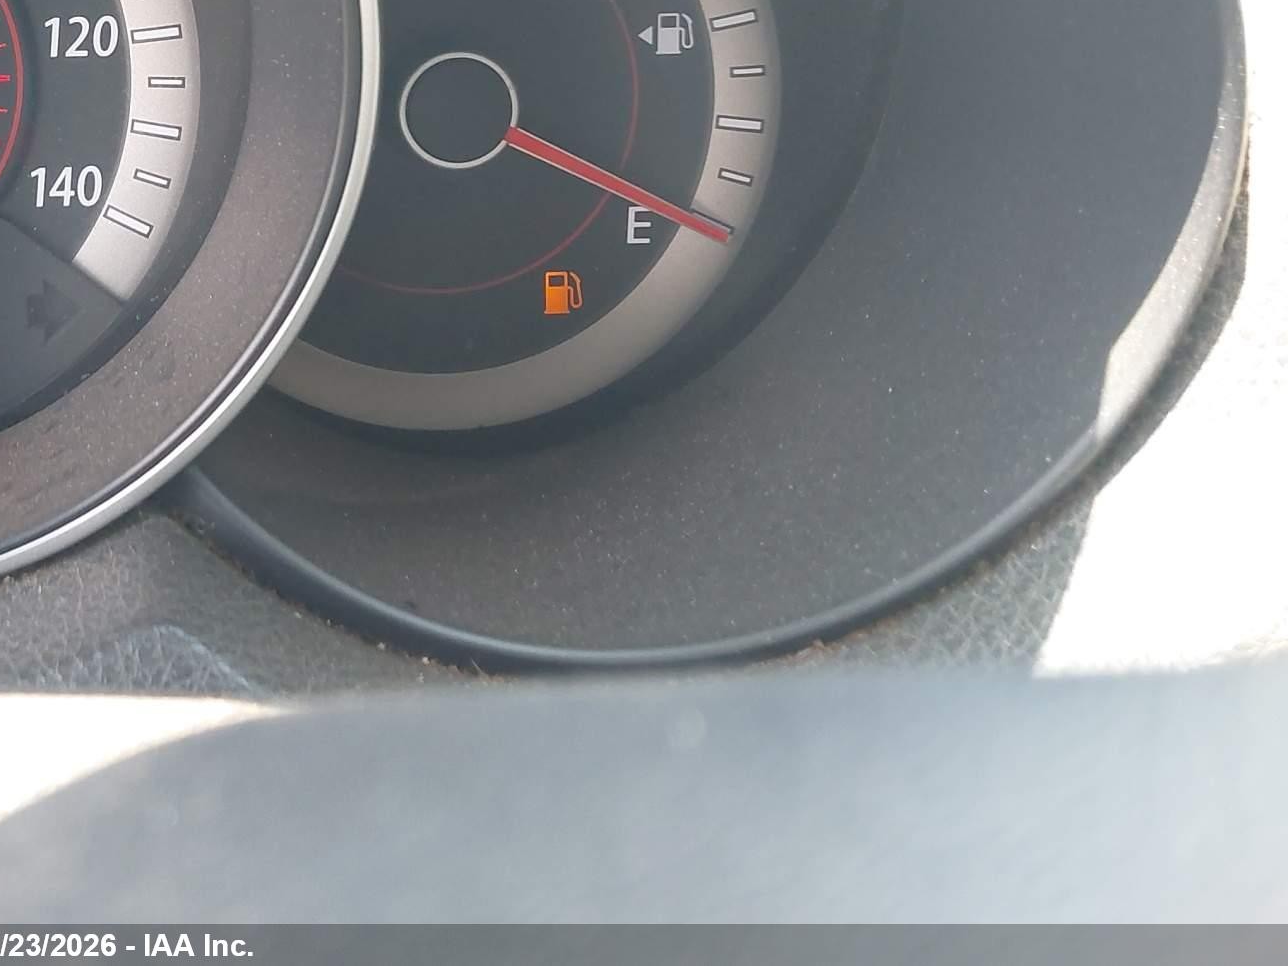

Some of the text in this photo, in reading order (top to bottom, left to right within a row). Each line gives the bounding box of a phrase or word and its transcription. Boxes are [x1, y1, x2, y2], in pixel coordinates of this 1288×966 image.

[44, 15, 118, 58] 120
[29, 165, 102, 207] 140
[627, 206, 651, 244] E
